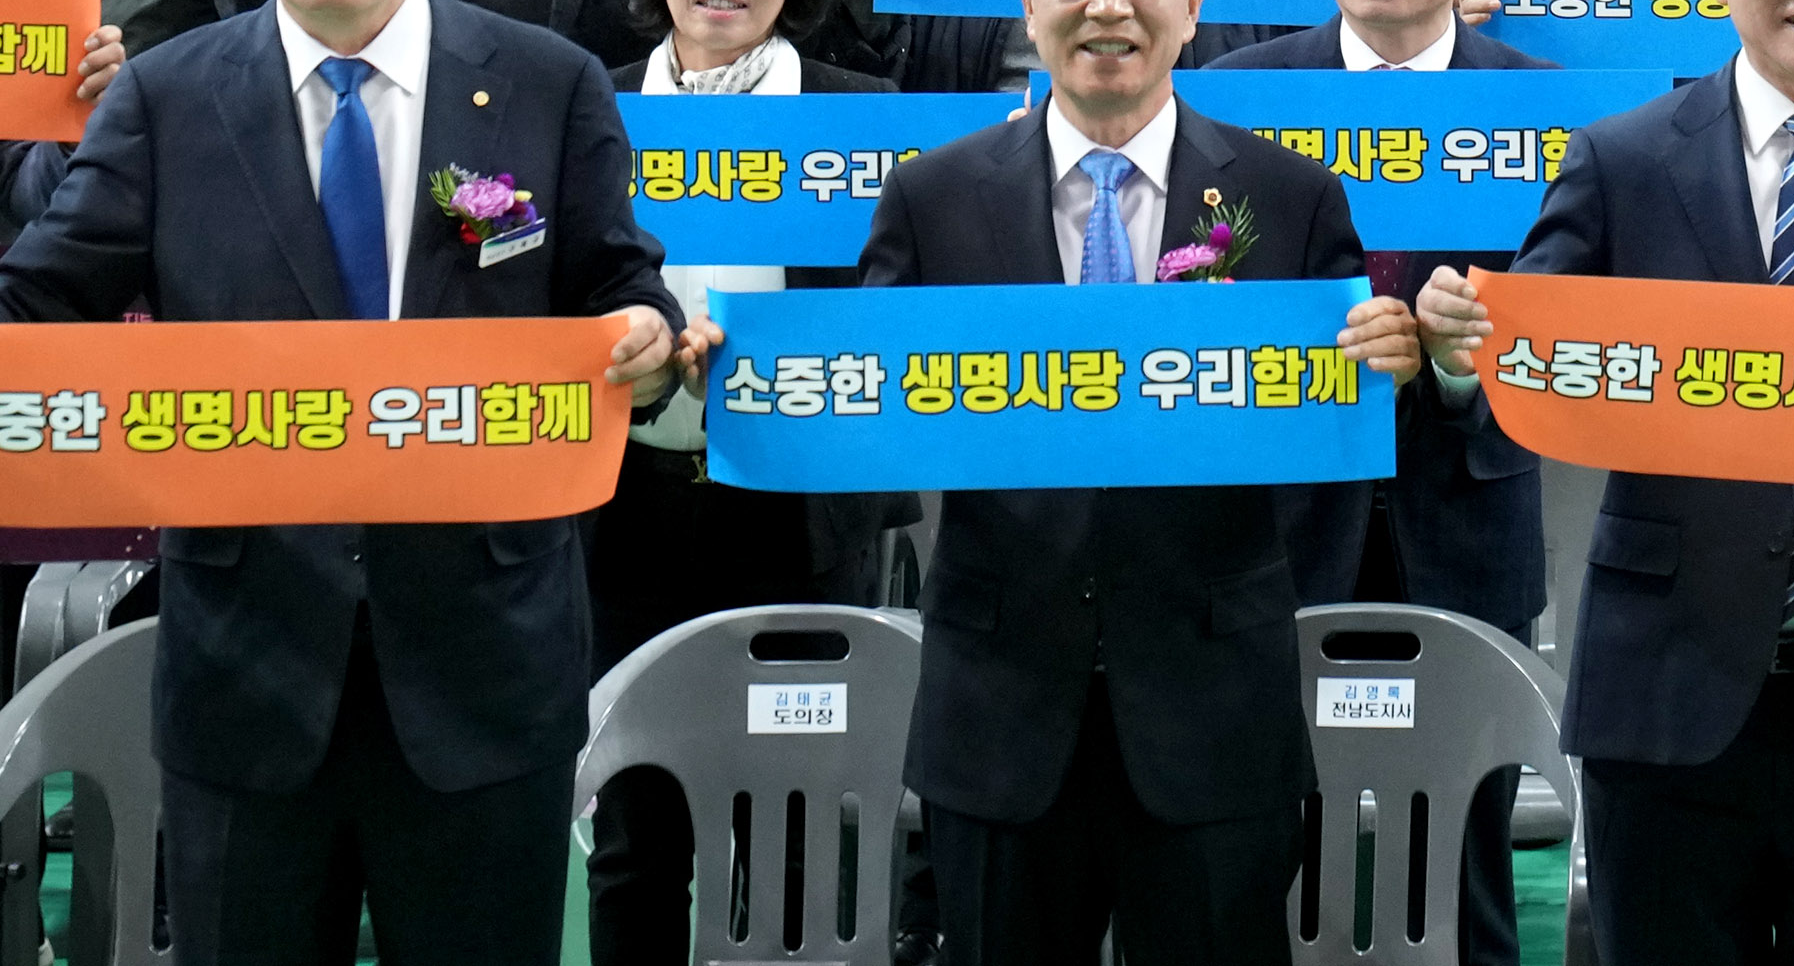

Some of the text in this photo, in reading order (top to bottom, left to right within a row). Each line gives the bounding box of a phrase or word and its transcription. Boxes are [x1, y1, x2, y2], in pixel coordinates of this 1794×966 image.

[630, 149, 892, 204] 명사랑 우리
[724, 345, 1359, 417] 소중한 생명사랑 우리함께
[1497, 338, 1662, 402] 소중한
[122, 389, 352, 451] 생명사랑
[368, 382, 591, 448] 우리함께
[773, 708, 834, 726] 도의장
[1332, 702, 1411, 720] 전남도지사
